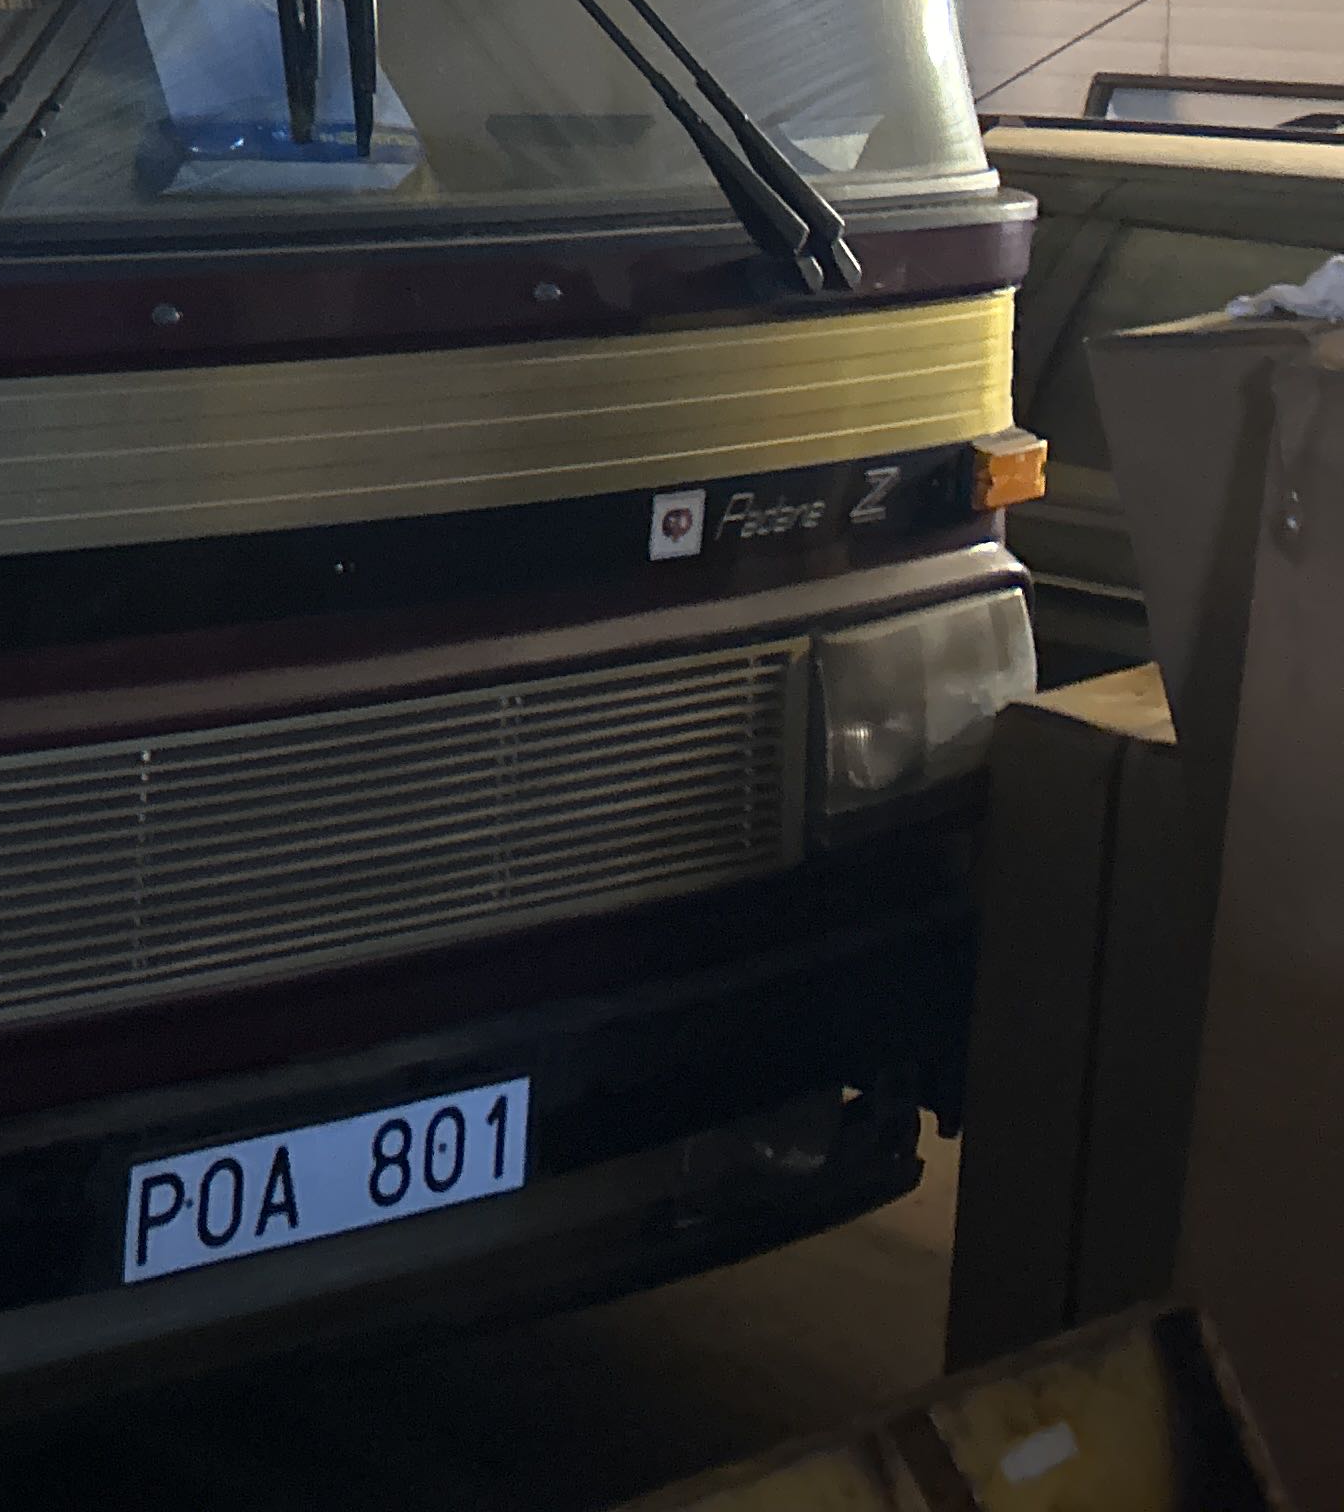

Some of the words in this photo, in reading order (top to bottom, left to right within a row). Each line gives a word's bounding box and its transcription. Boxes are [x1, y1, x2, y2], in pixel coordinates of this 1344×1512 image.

[849, 465, 902, 525] Z
[135, 1144, 301, 1267] POA
[367, 1093, 511, 1208] 801
